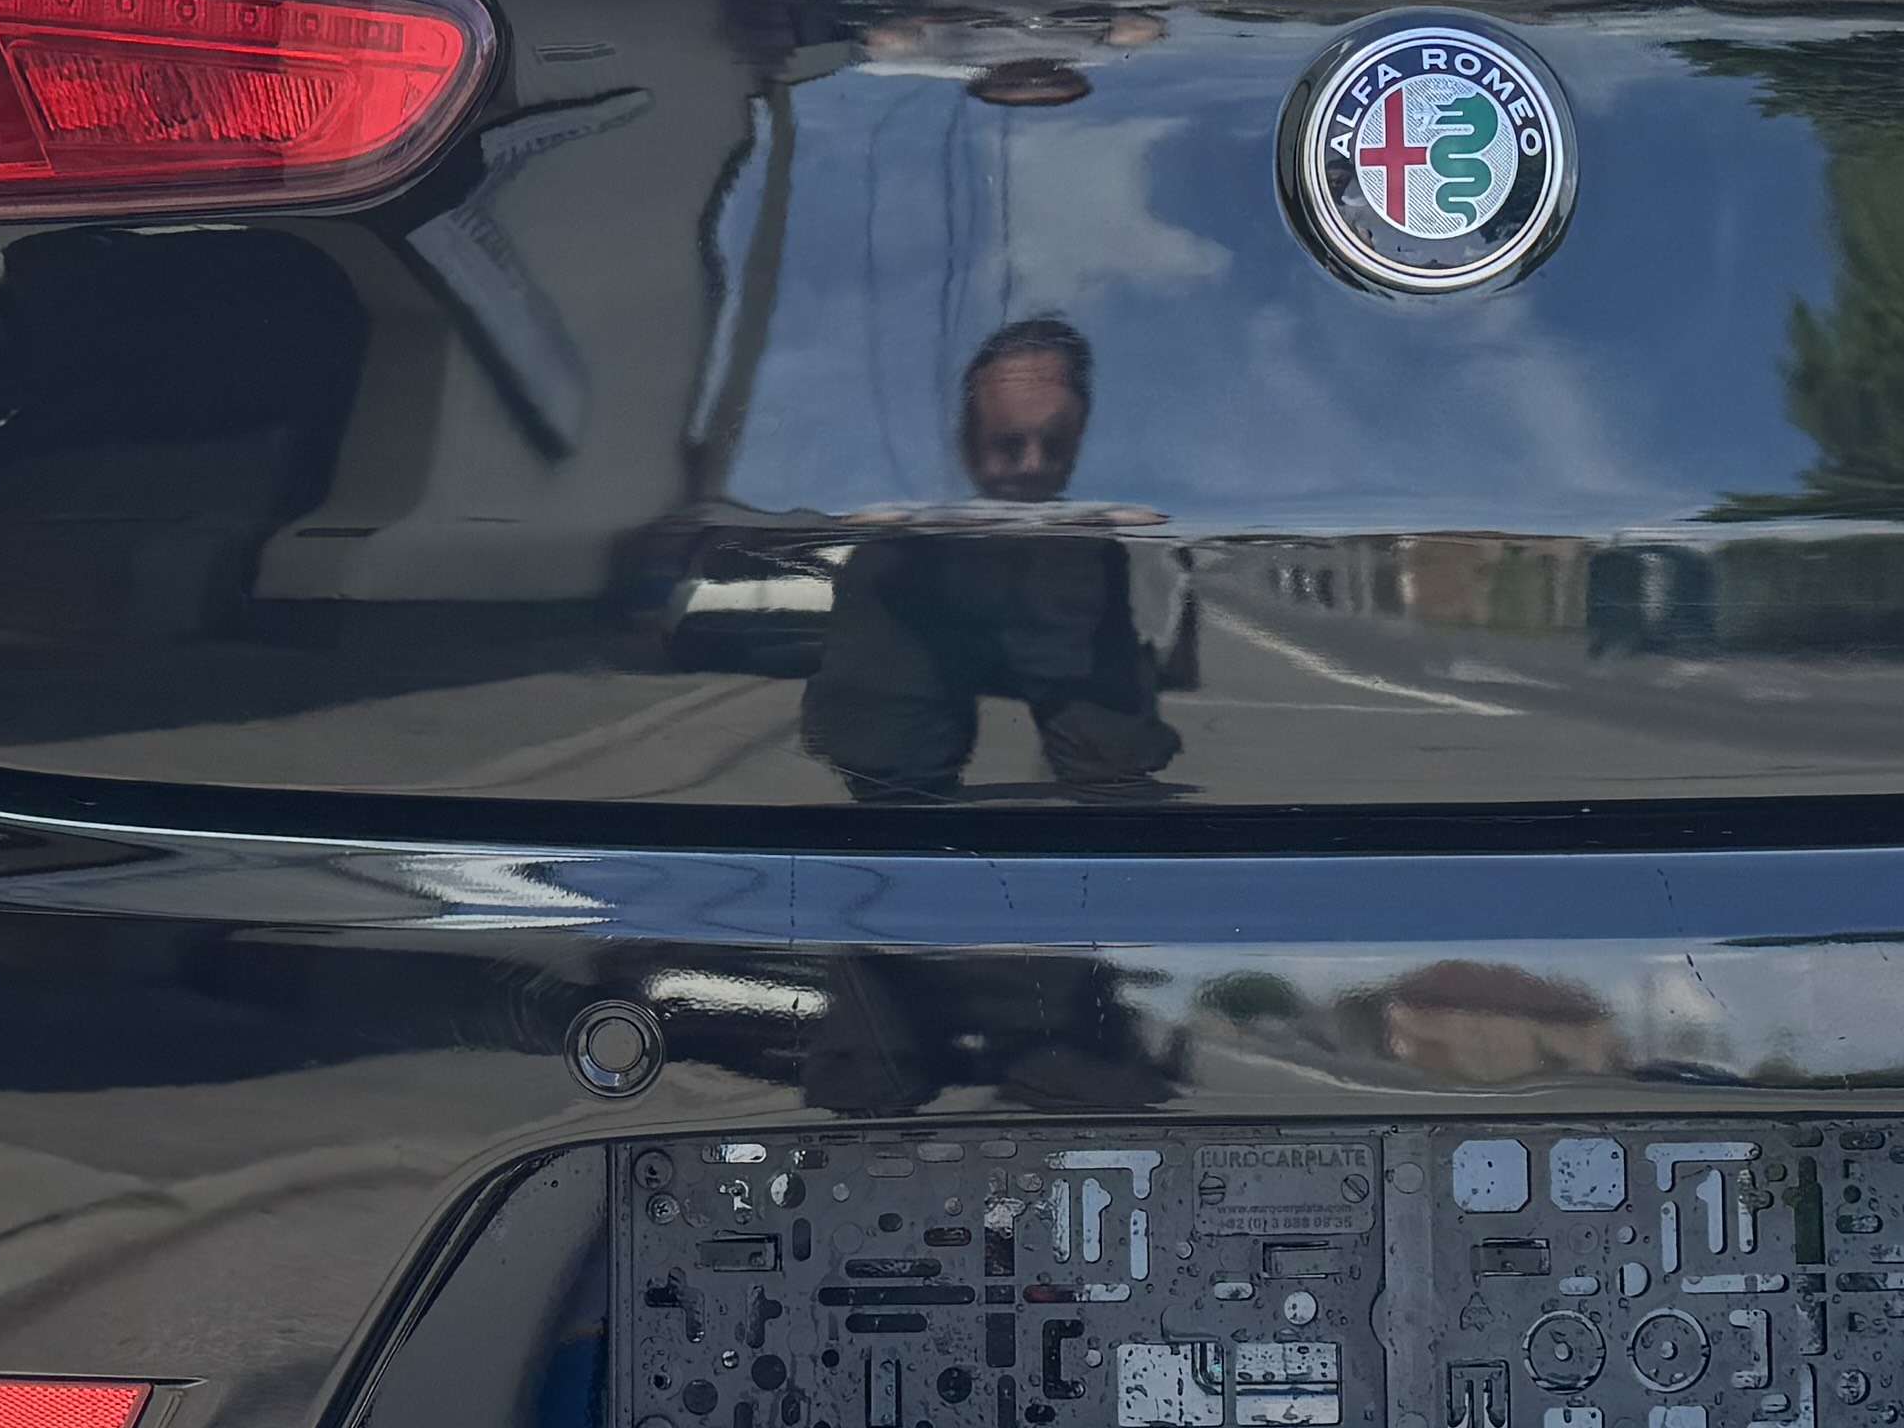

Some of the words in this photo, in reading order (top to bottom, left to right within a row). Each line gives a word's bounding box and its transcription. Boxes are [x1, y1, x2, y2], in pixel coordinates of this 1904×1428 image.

[1330, 62, 1403, 160] ALFA
[1421, 48, 1543, 157] ROMEO
[1201, 1149, 1367, 1169] EUROCARPLATE
